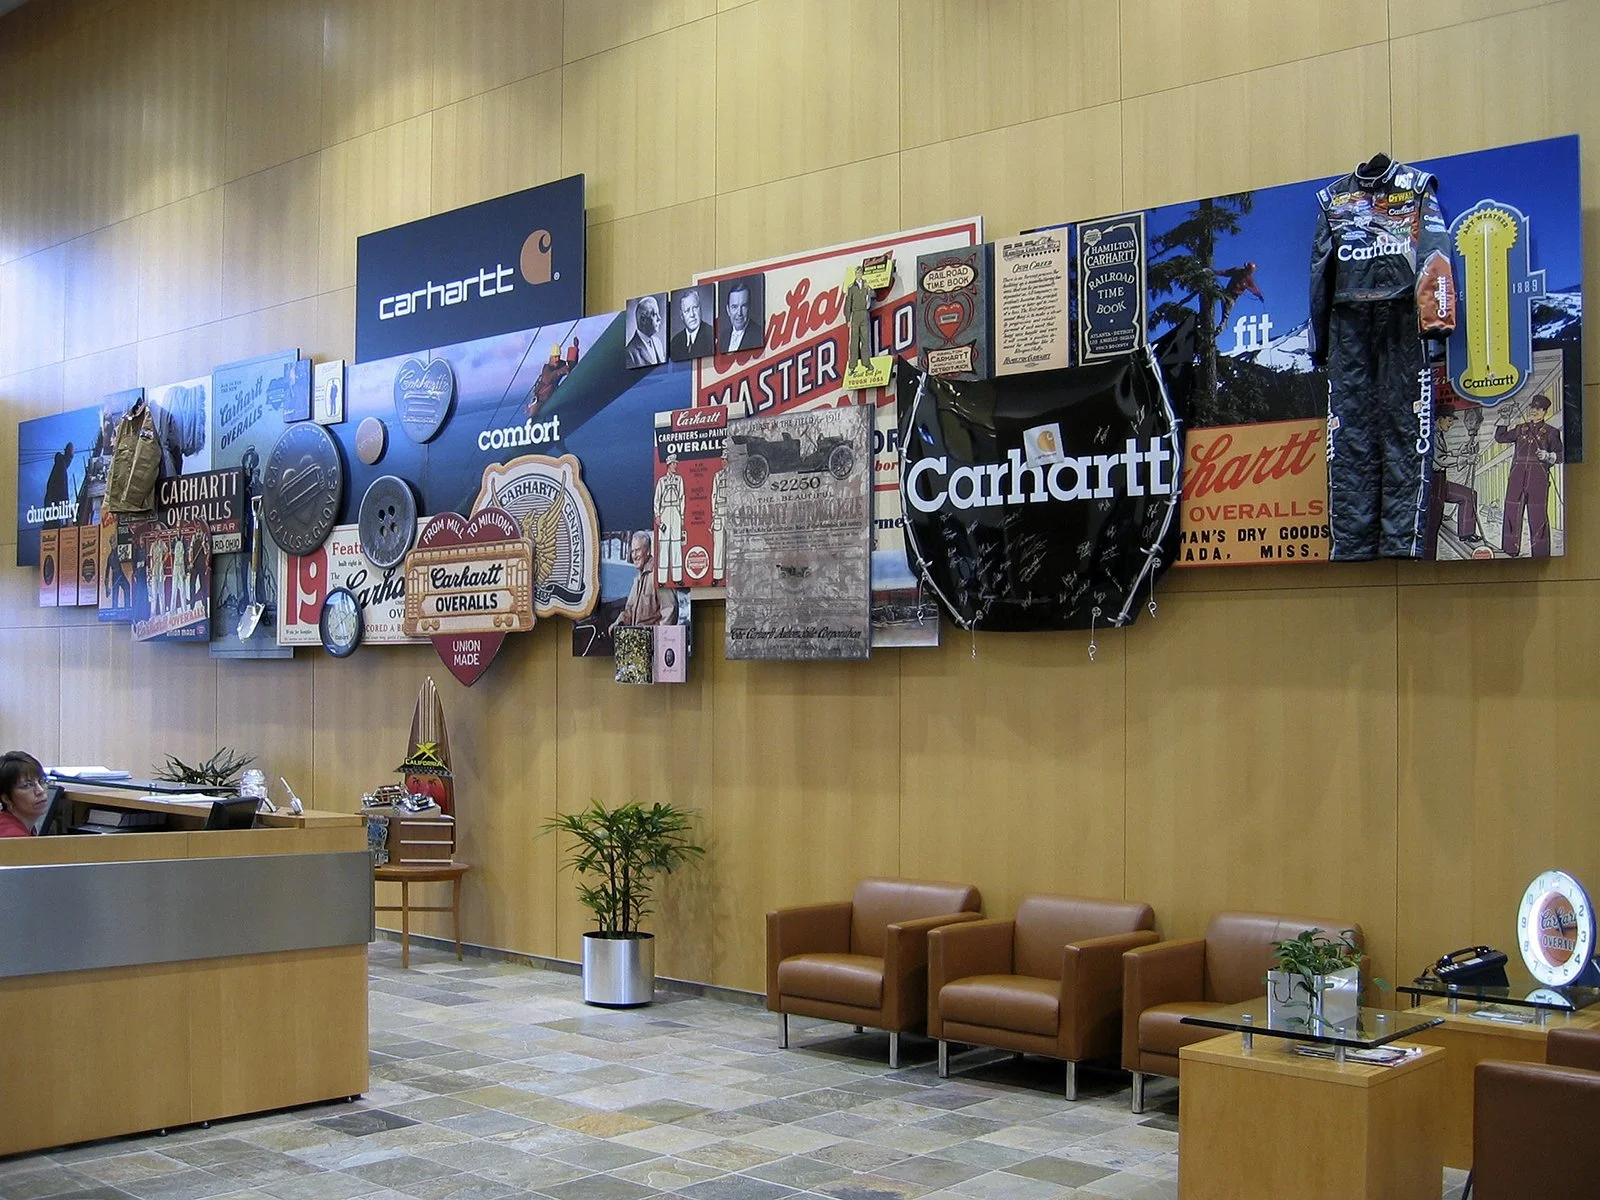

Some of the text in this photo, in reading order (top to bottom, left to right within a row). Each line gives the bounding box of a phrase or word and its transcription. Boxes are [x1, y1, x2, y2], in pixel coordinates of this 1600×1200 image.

[1091, 240, 1134, 256] HAMILTON
[1338, 236, 1411, 262] Carhartt
[1087, 249, 1135, 267] CARHARTT
[927, 276, 969, 290] TIME BOOK
[929, 267, 968, 282] RAILROAD
[1088, 272, 1135, 290] RAILROAD
[379, 264, 514, 321] carhartt
[1098, 287, 1125, 300] TIME
[1512, 279, 1538, 295] 1889
[1434, 276, 1446, 318] Carhartt
[1096, 301, 1127, 314] BOOK
[1233, 314, 1273, 353] fit
[930, 351, 969, 364] CARHARTT
[708, 339, 838, 416] MASTER
[1463, 374, 1515, 390] Carhartt
[220, 375, 263, 428] Carhartt
[677, 411, 720, 427] Carhartt
[1416, 368, 1431, 454] Carhartt
[221, 404, 262, 450] OVERALLS
[478, 414, 560, 451] comfort
[658, 430, 698, 443] CARPENTERS
[667, 438, 728, 454] OVERALLS
[907, 436, 1170, 513] Carhartt
[161, 471, 239, 506] CARHARTT
[770, 476, 821, 492] $2250
[313, 465, 338, 540] GLOVES
[500, 480, 562, 508] CARHARTT
[781, 491, 834, 502] BEAUTIFUL
[26, 500, 79, 524] durability
[167, 500, 232, 526] OVERALLS
[1188, 500, 1324, 522] OVERALLS
[423, 512, 514, 545] FROM MILL TO MILLIONS
[1238, 528, 1267, 542] DRY
[1279, 524, 1330, 540] GOODS
[226, 538, 240, 549] OHIO
[563, 502, 581, 584] CENTENNIAL
[1177, 543, 1319, 562] ADA, MISS.
[331, 572, 340, 580] The
[430, 563, 504, 589] Carhartt
[435, 593, 498, 612] OVERALLS
[452, 639, 481, 651] UNION
[454, 654, 480, 666] MADE
[1579, 905, 1585, 917] 2
[1522, 917, 1527, 928] 9
[1581, 931, 1587, 942] 3
[1524, 941, 1529, 951] 8
[1575, 953, 1581, 964] 4
